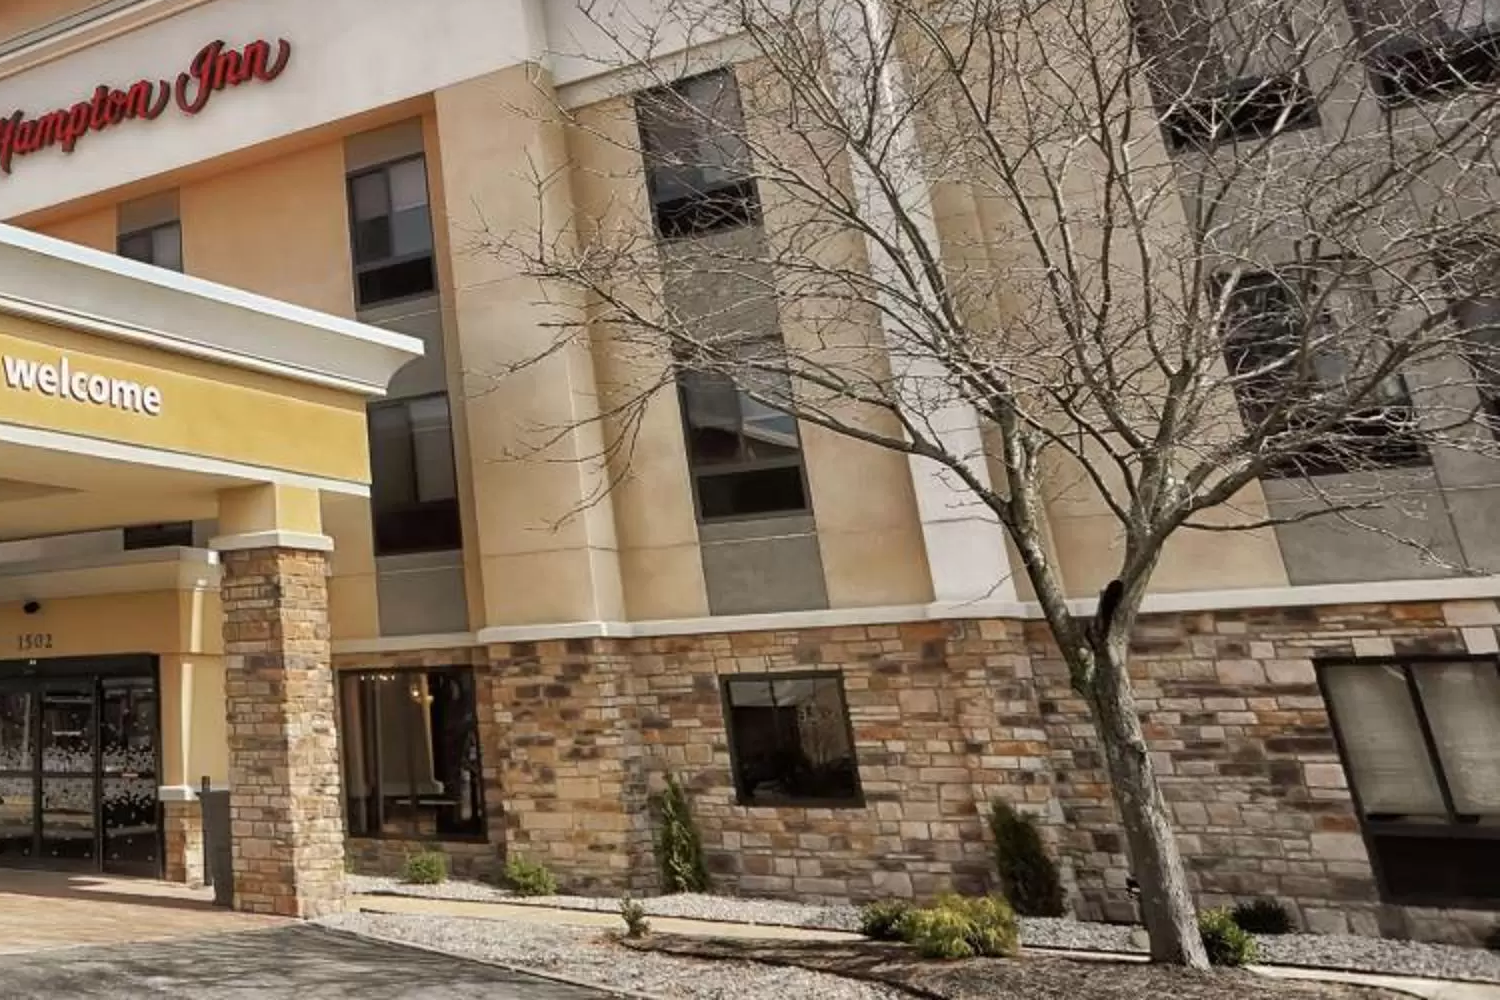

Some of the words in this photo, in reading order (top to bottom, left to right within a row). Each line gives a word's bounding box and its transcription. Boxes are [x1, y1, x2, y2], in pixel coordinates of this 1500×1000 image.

[176, 38, 291, 115] Inn
[3, 354, 161, 415] welcome
[17, 633, 53, 650] 1502
